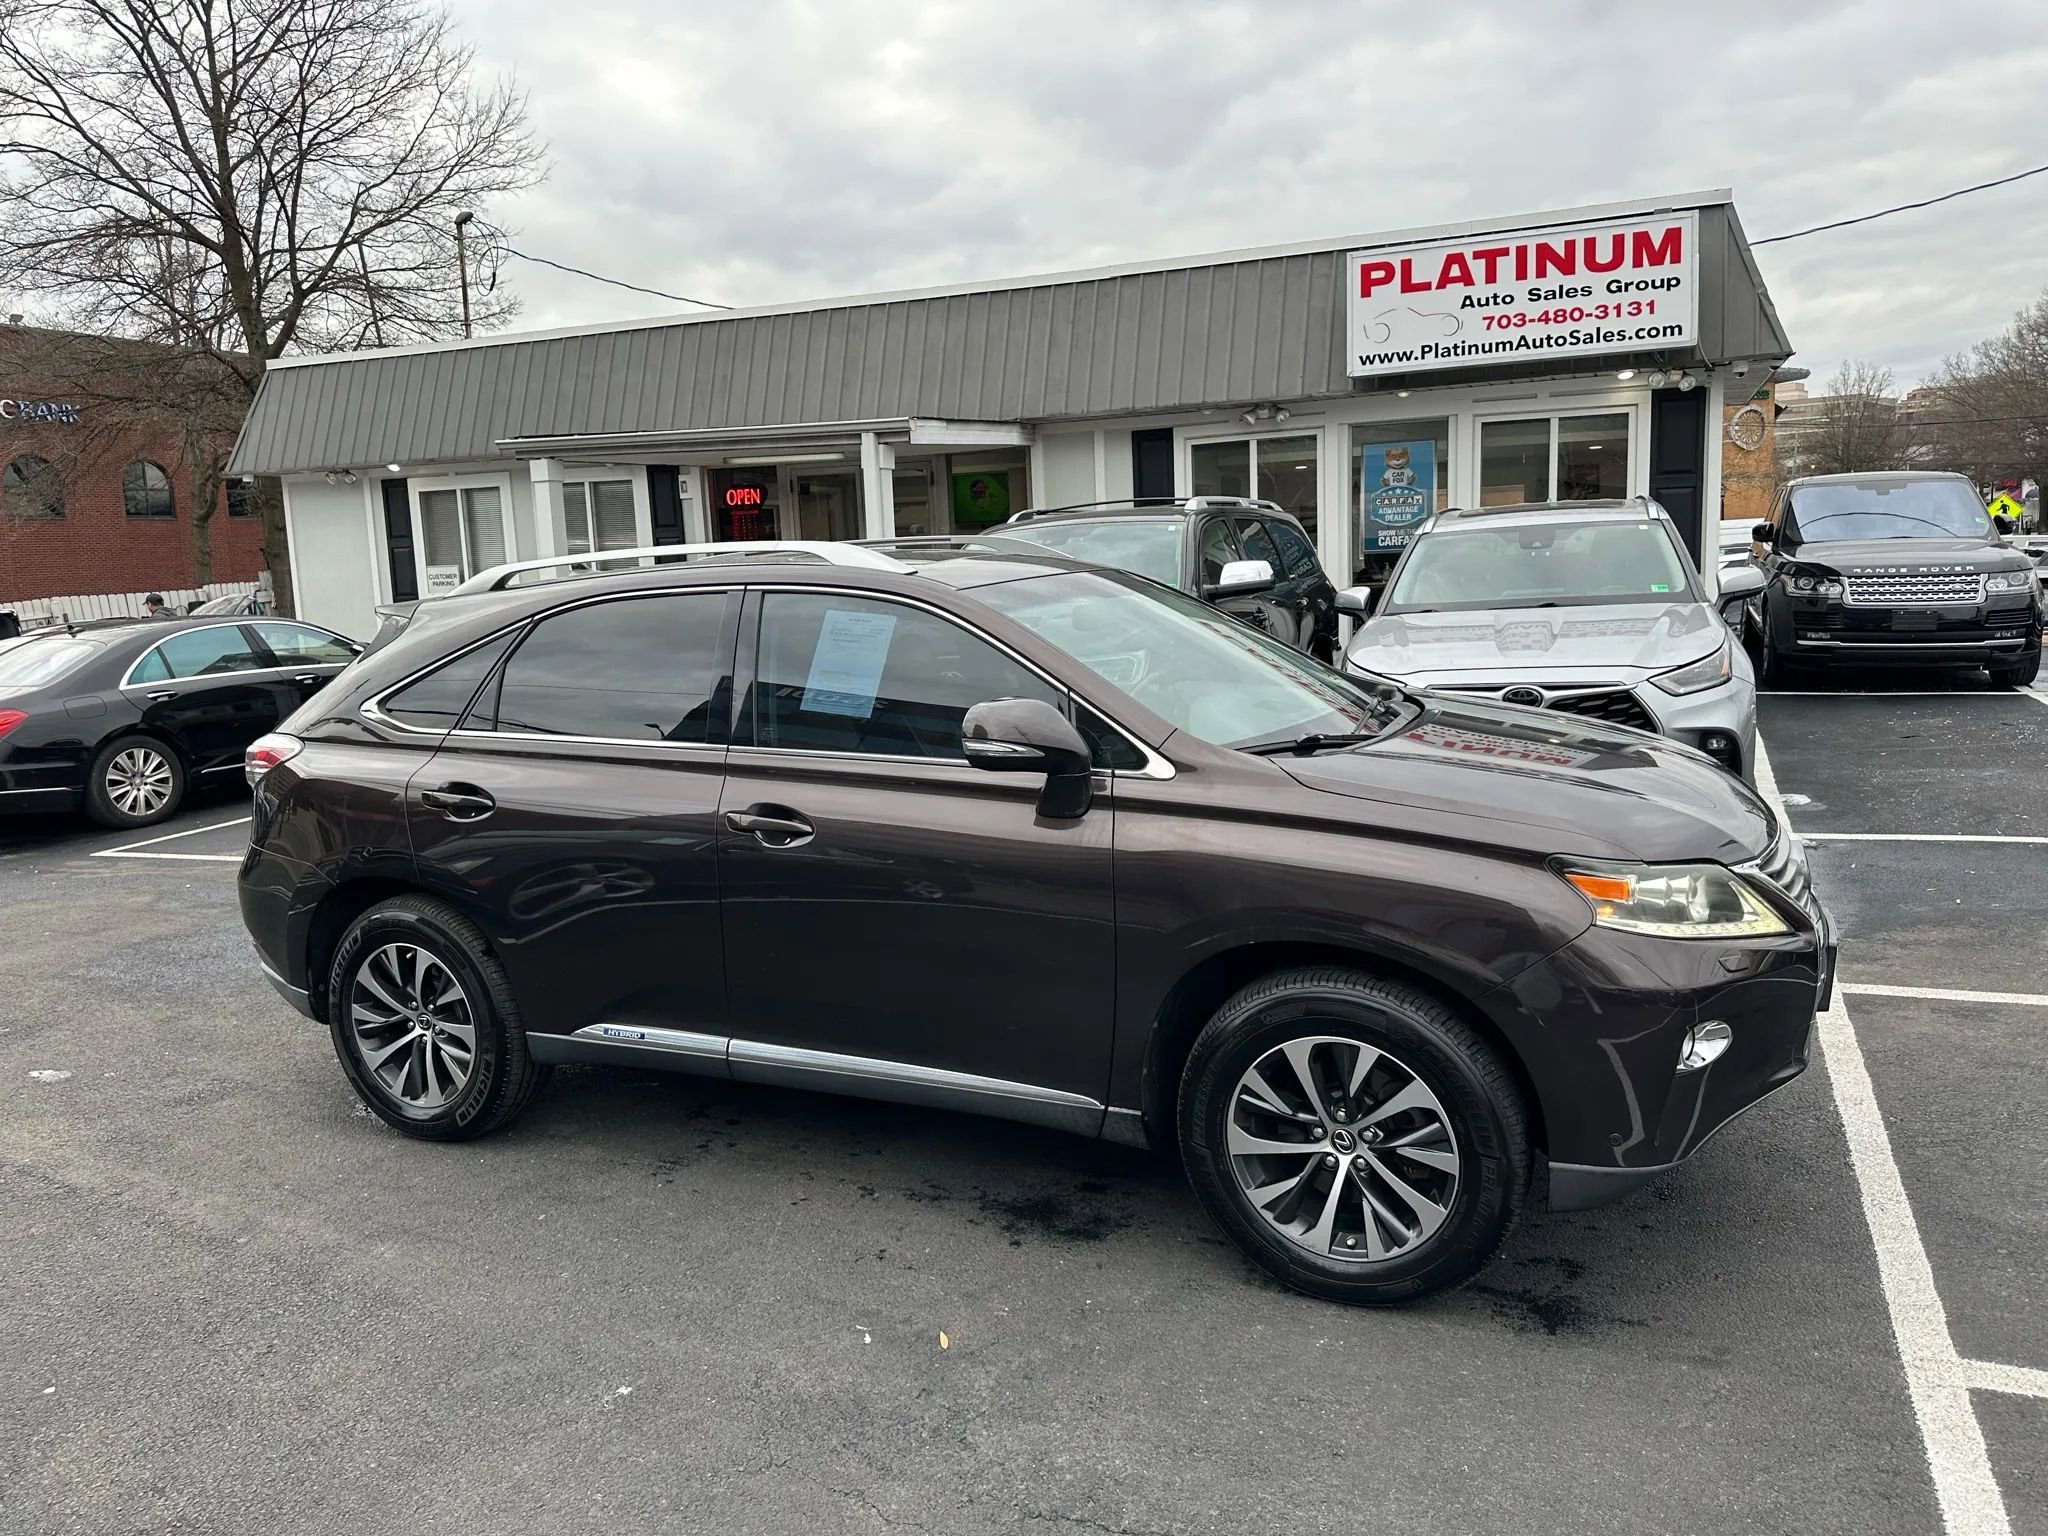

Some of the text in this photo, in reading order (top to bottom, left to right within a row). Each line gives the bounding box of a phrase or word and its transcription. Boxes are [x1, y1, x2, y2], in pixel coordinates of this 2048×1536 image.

[1360, 226, 1682, 298] PLATINUM
[1460, 276, 1681, 310] Auto Sales Group
[1482, 299, 1656, 331] 703-480-3131
[1358, 322, 1684, 366] www.PlatinumAutoSales.com
[726, 488, 760, 506] OPEN
[1375, 496, 1422, 506] CARFAX
[1378, 505, 1420, 515] ADVANTAGE
[1384, 513, 1412, 522] DEALER
[1377, 529, 1397, 537] SHOW
[1377, 535, 1414, 547] CARFA
[1919, 565, 1975, 573] ROVER
[428, 573, 458, 581] CUSTOMER
[607, 1029, 641, 1040] HYBRID
